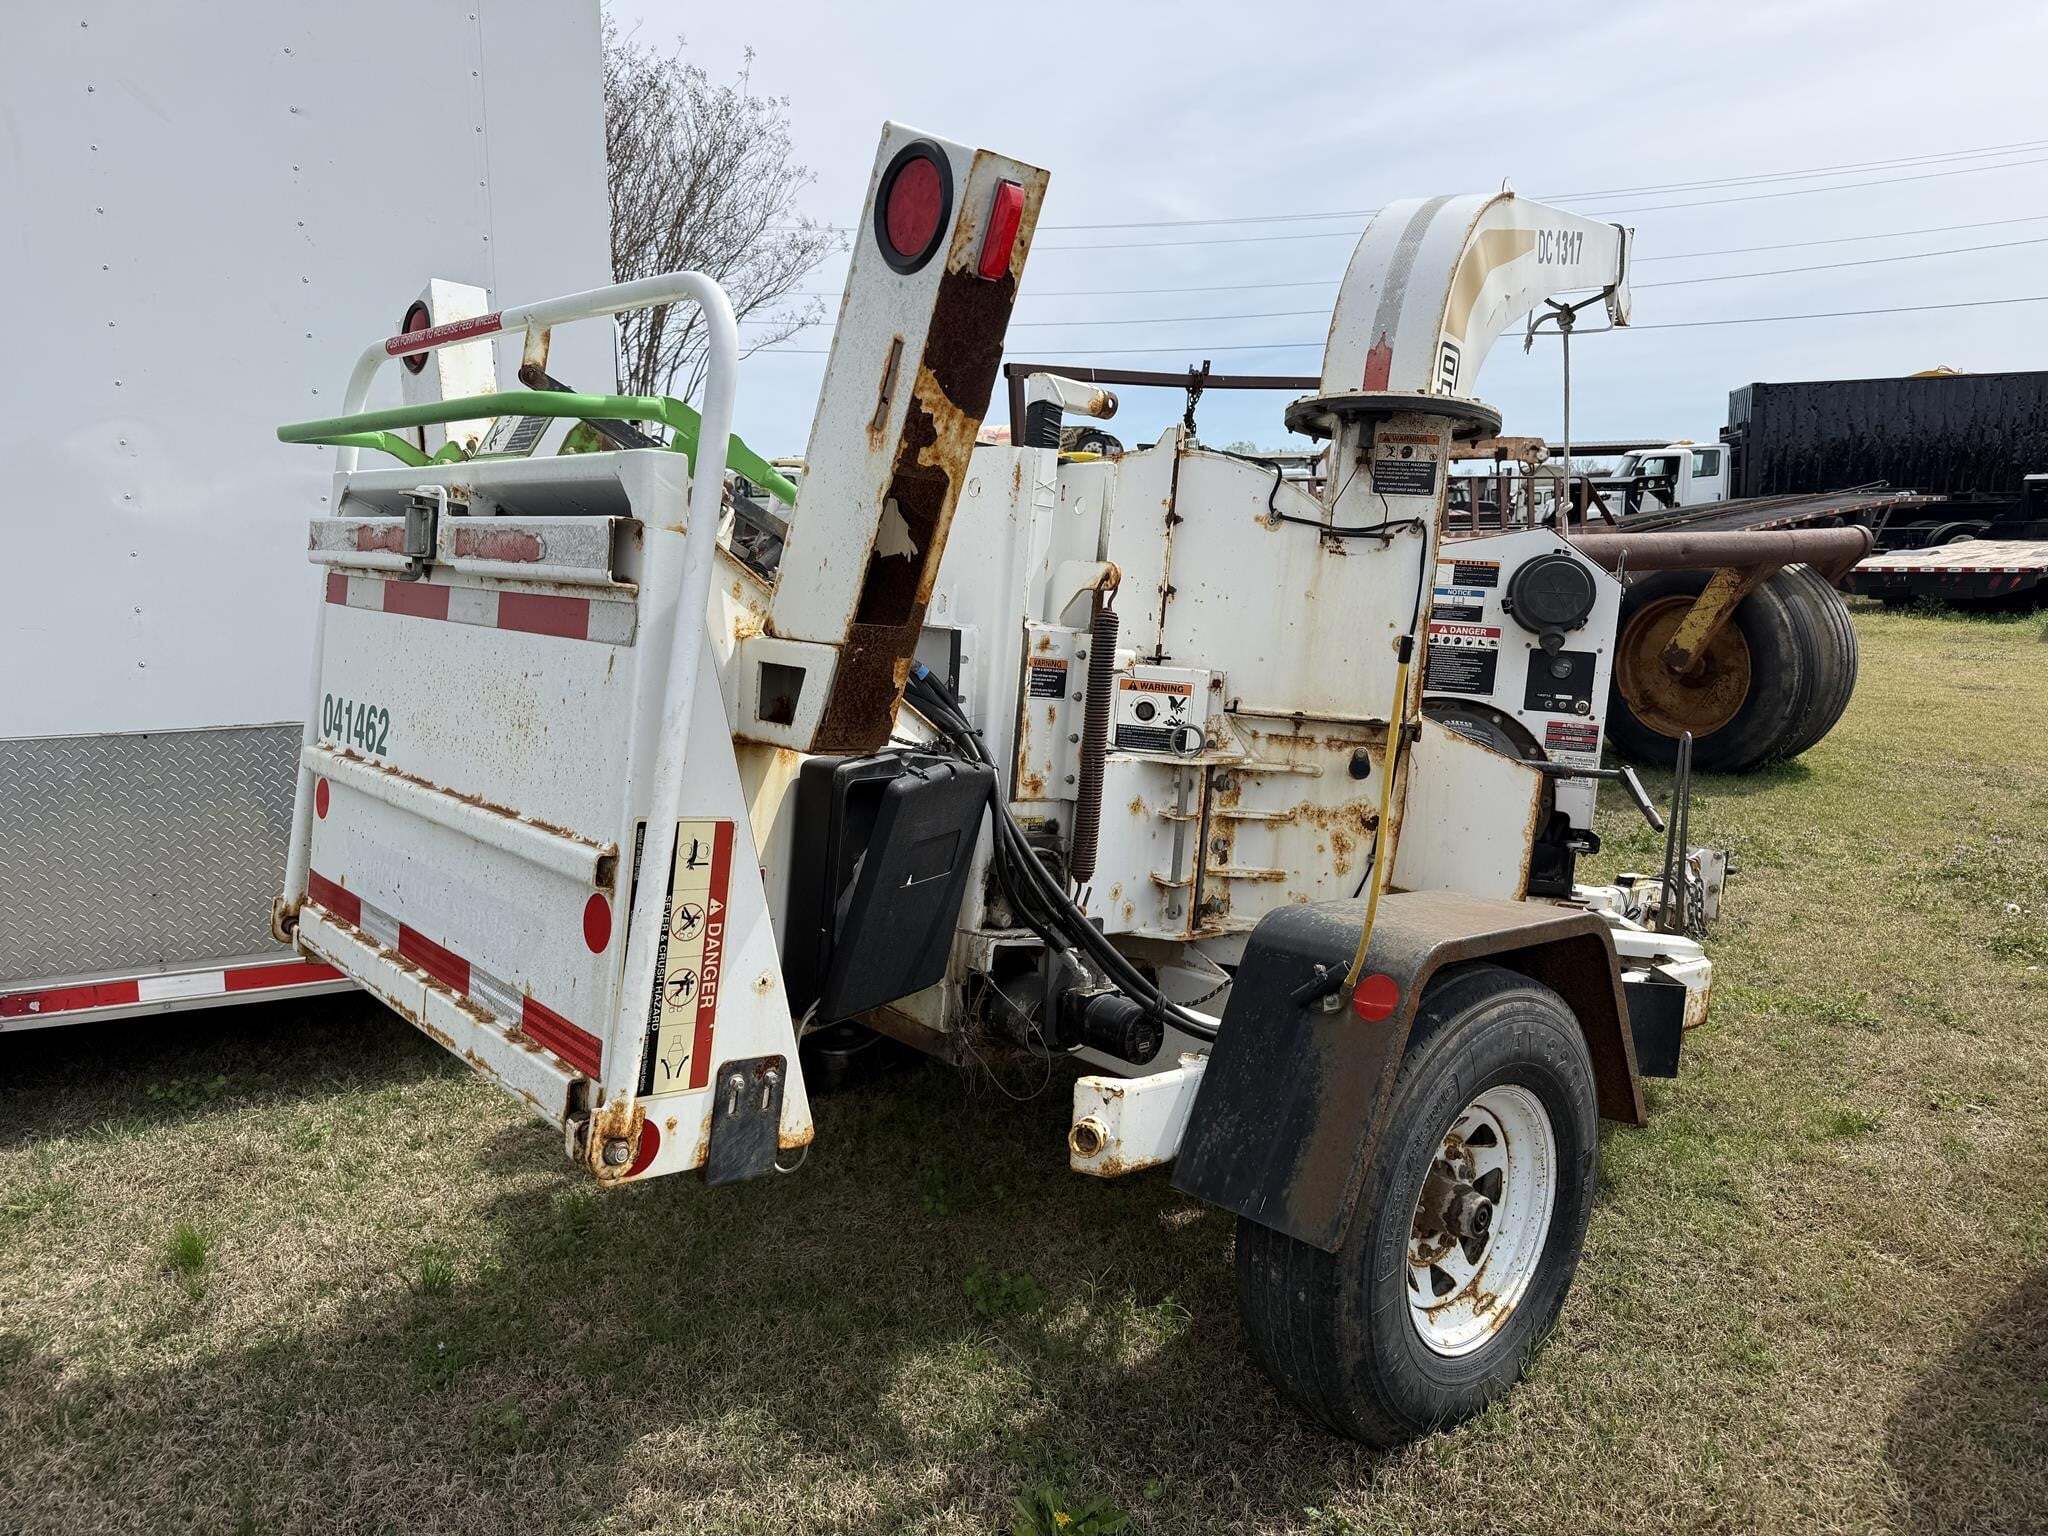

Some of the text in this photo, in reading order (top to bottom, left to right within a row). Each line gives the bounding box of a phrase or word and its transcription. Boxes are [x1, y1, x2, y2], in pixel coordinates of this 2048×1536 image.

[1538, 229, 1584, 265] DC 1317
[1392, 434, 1428, 443] WARNING
[1450, 627, 1487, 636] DANGER
[1140, 682, 1184, 694] WARNING
[323, 693, 389, 757] 041462
[652, 895, 672, 1031] SEVER & CRUSH HAZARD
[700, 923, 721, 1008] DANGER
